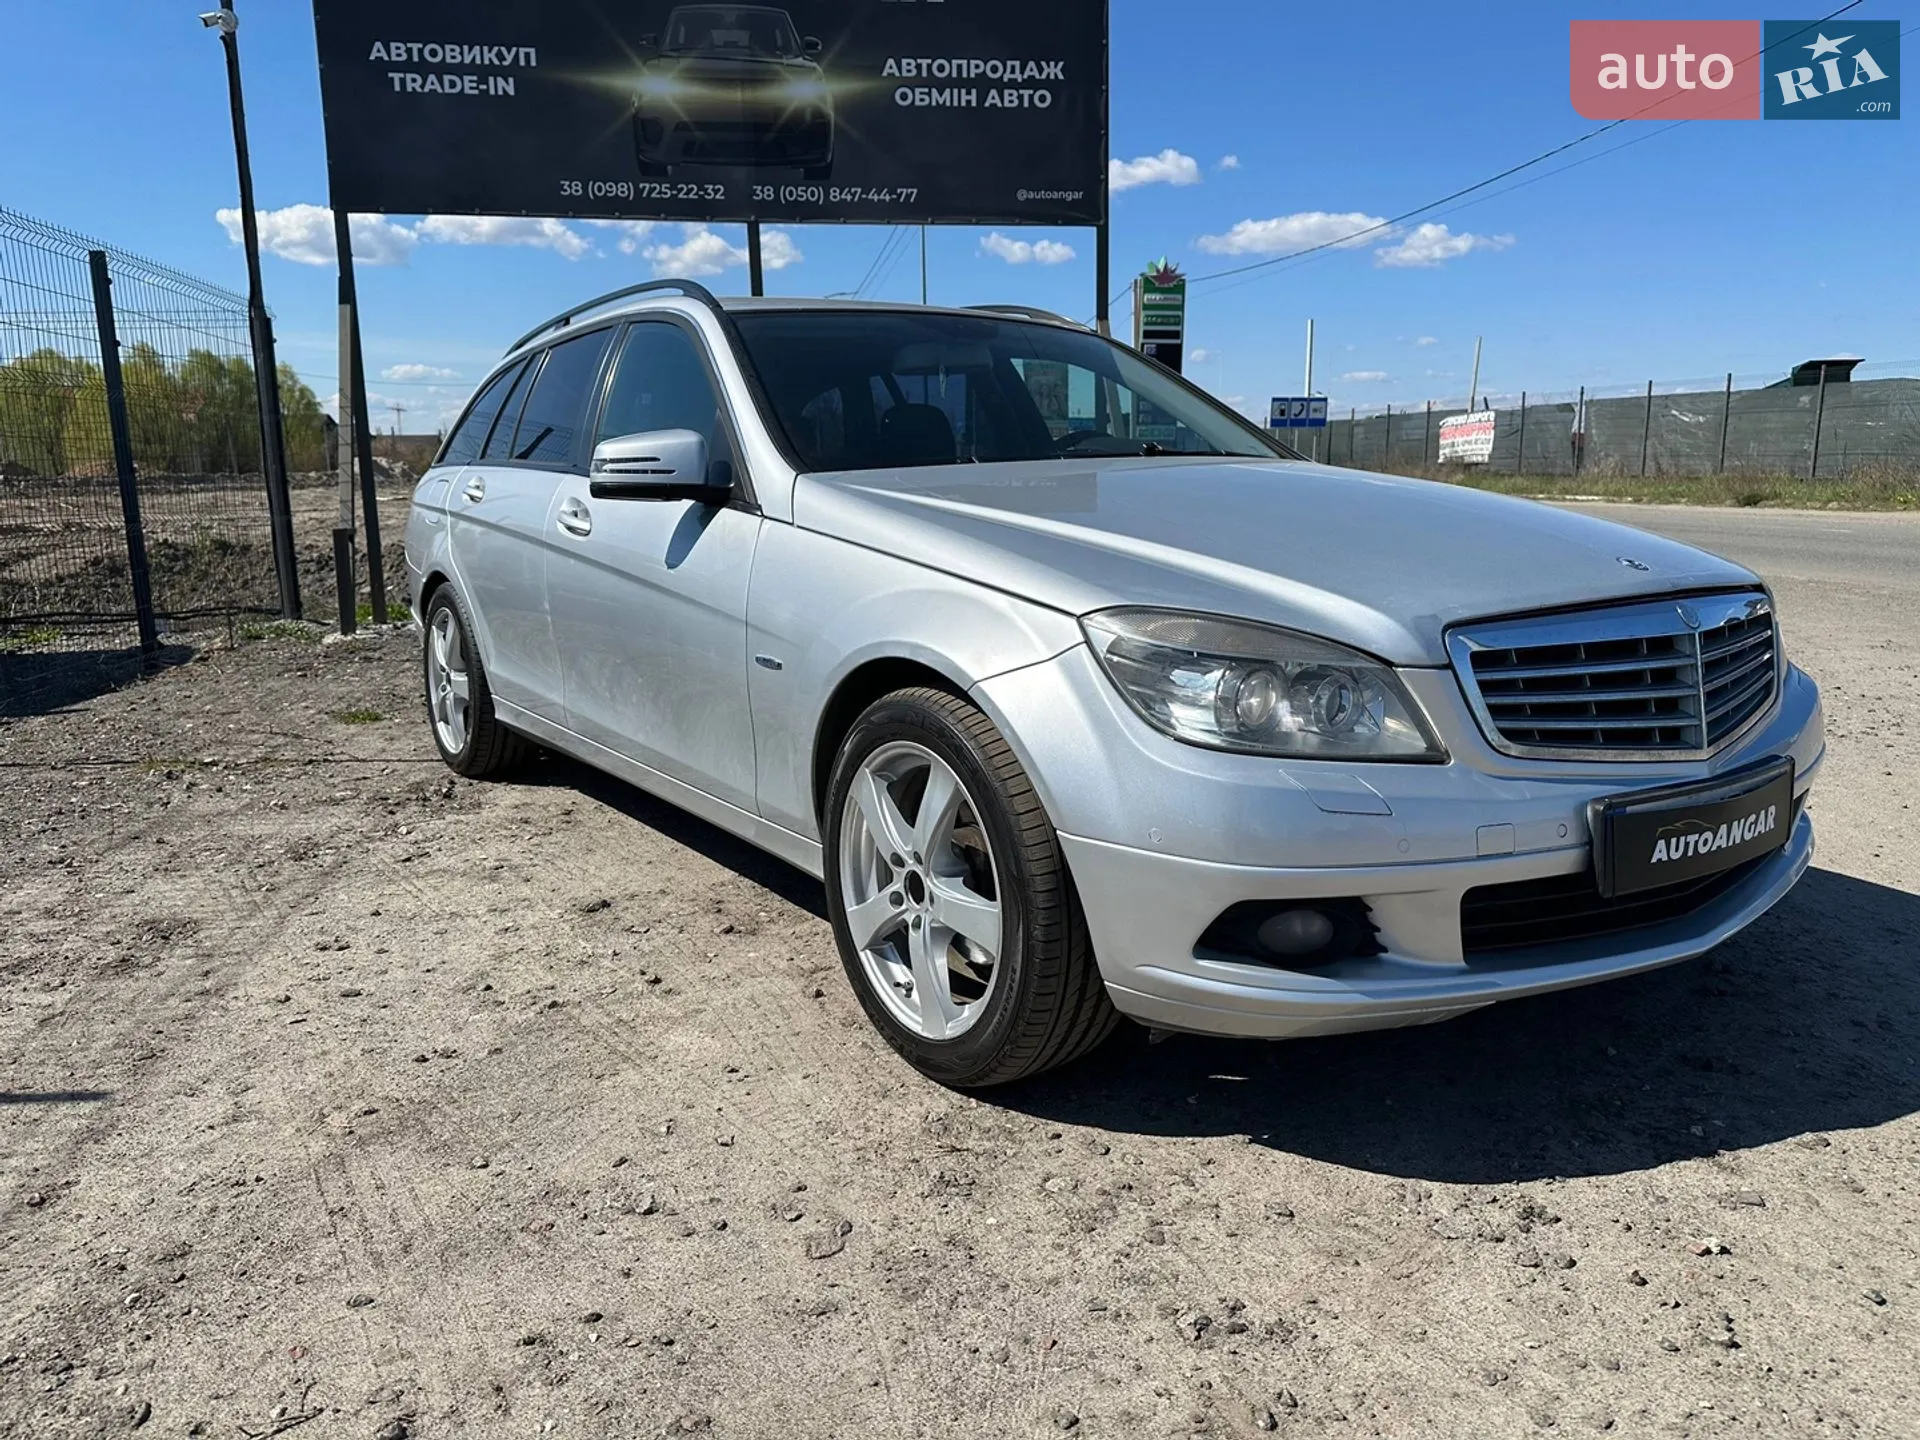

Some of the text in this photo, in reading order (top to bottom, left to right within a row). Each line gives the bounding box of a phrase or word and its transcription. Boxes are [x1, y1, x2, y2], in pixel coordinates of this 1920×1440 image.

[369, 41, 537, 67] АВТОВИКУП
[882, 58, 1065, 80] АВТОПРОДАЖ
[388, 72, 515, 96] TRADE-IN
[895, 87, 1052, 108] ОБМІН АВТО
[559, 181, 725, 200] 38 (098) 725-22-32
[752, 185, 918, 205] 38 (050) 847-44-77
[1016, 188, 1084, 202] @autoangar
[1651, 804, 1776, 864] AUTOANGAR
